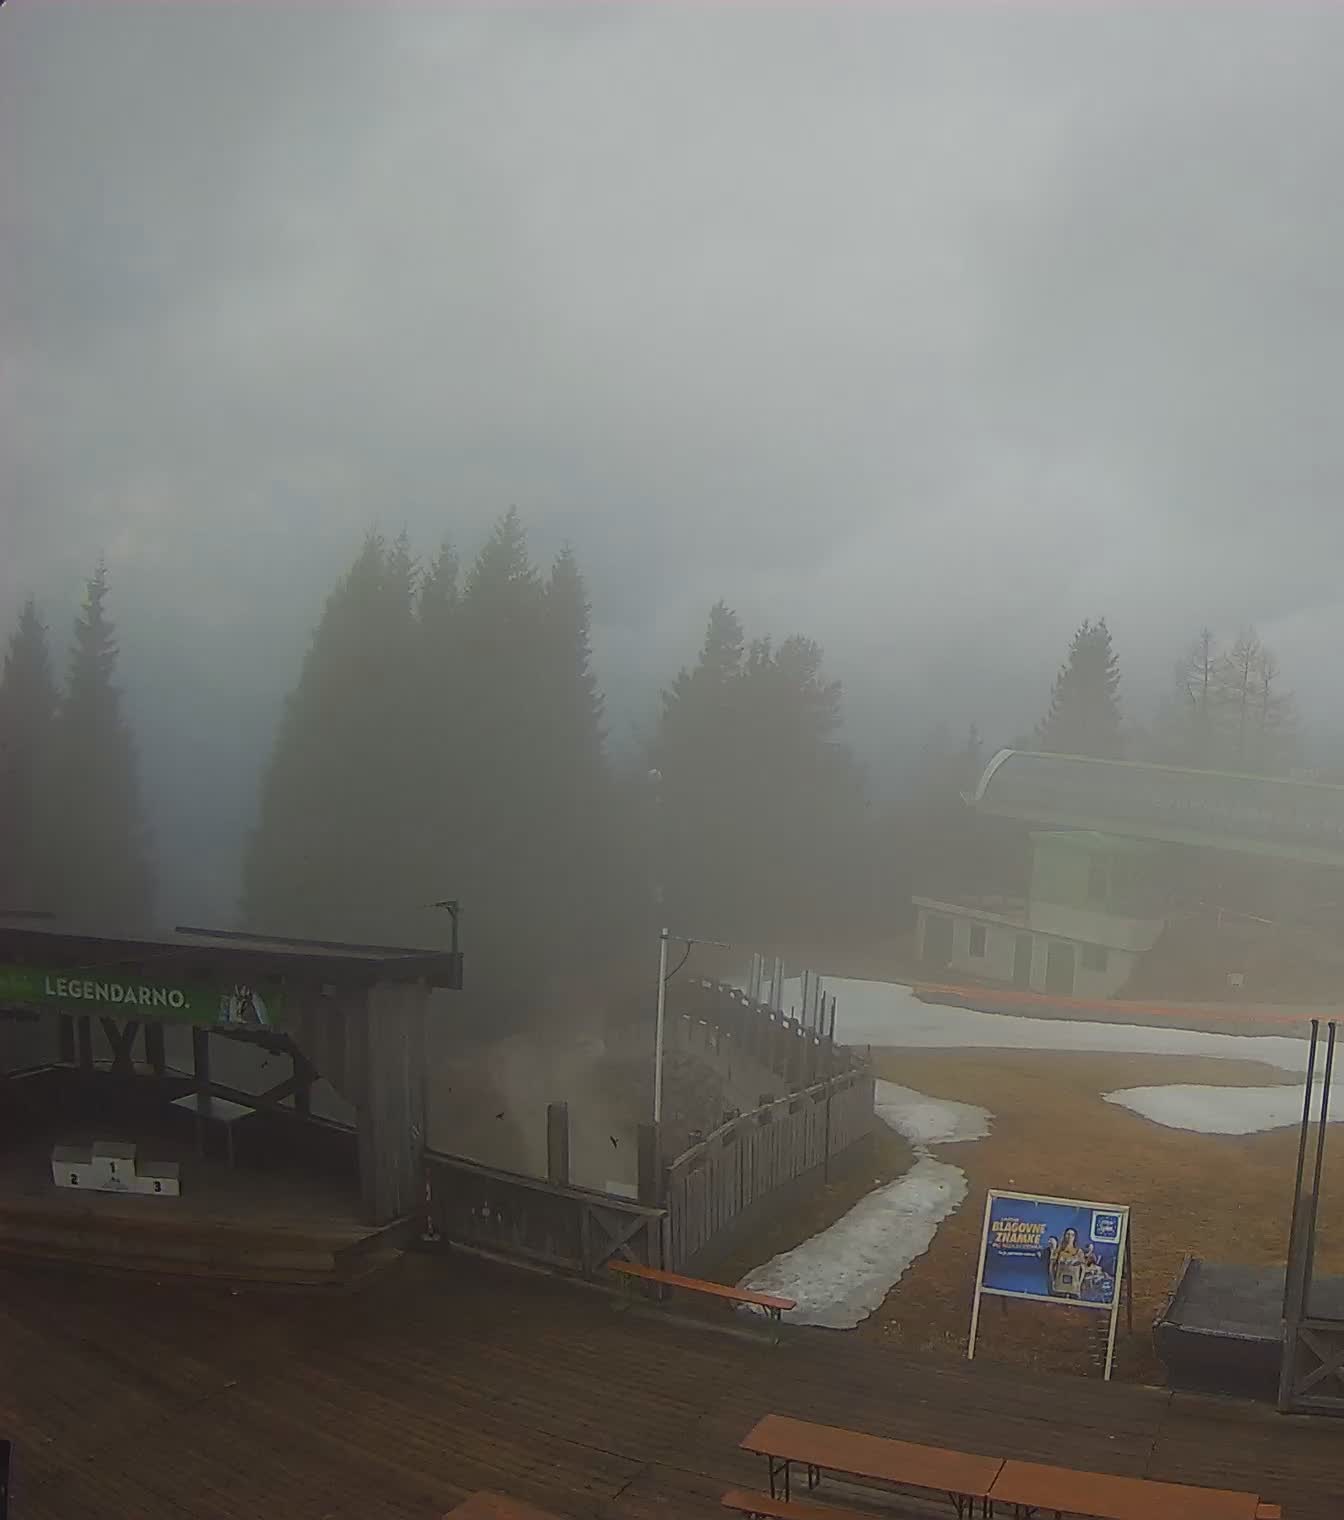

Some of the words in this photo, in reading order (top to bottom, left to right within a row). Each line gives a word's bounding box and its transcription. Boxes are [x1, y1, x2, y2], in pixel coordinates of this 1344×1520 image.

[45, 975, 191, 1009] LEGENDARNO.
[70, 1173, 79, 1185] 2
[153, 1181, 162, 1193] 3
